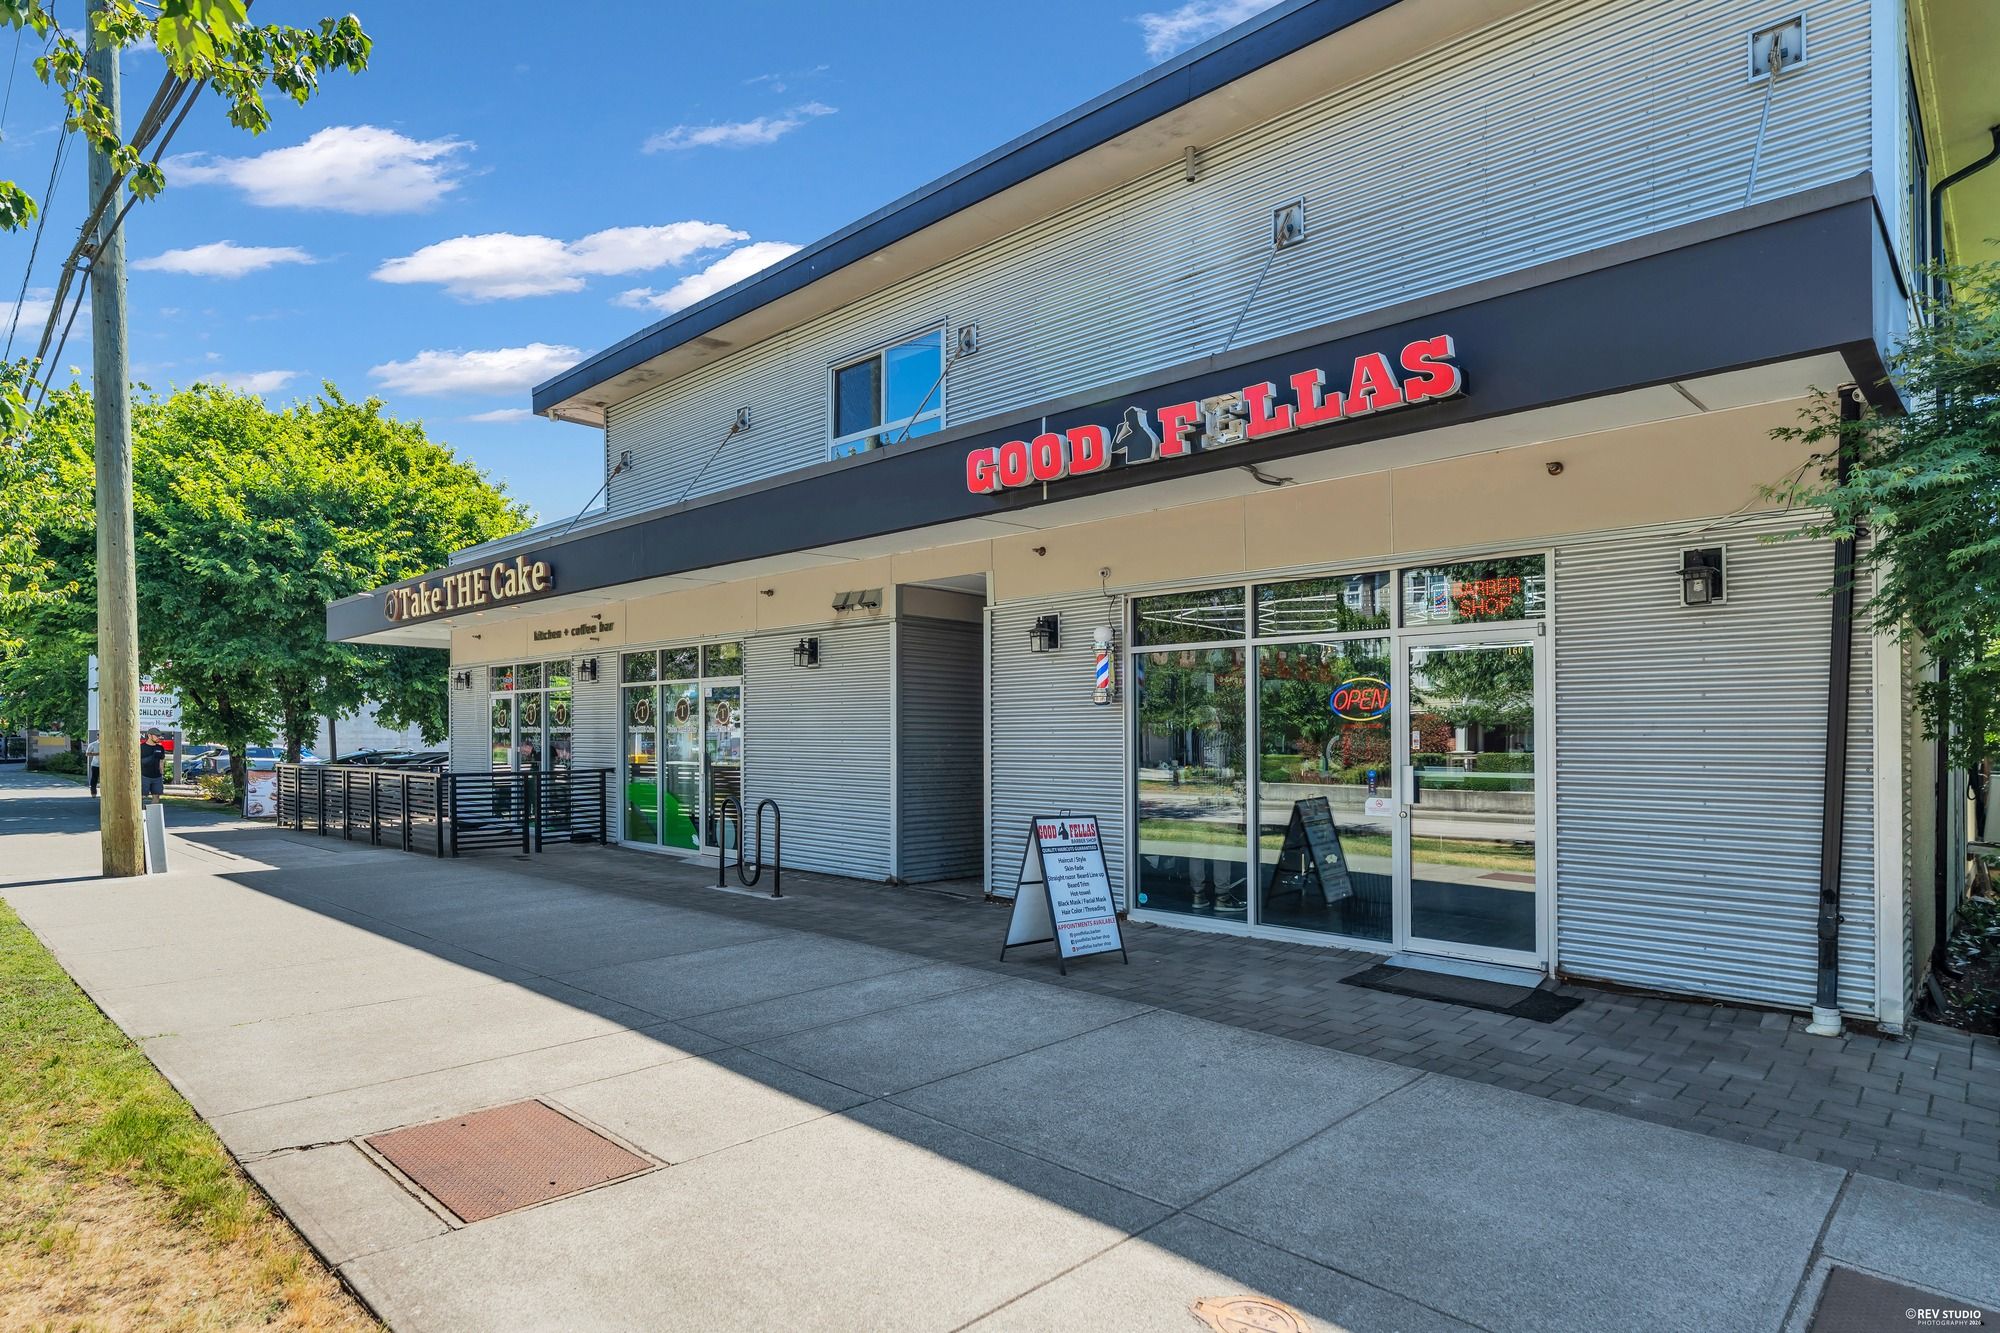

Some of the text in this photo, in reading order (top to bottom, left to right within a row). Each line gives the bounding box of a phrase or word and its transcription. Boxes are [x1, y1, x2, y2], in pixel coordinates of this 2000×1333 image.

[966, 334, 1462, 494] GOOD FELLAS
[400, 555, 548, 620] Take THE Cake
[1452, 577, 1520, 599] BARBER
[1460, 597, 1512, 617] SHOP
[534, 629, 562, 641] kitchen
[571, 624, 597, 636] coffee
[599, 621, 614, 632] bar
[1508, 648, 1523, 656] 160
[1333, 688, 1389, 711] OPEN
[139, 709, 173, 717] CHILDCARE
[1039, 824, 1095, 839] GOOD FELLAS
[1057, 917, 1115, 930] APPOINTMENTS AVAILABLE
